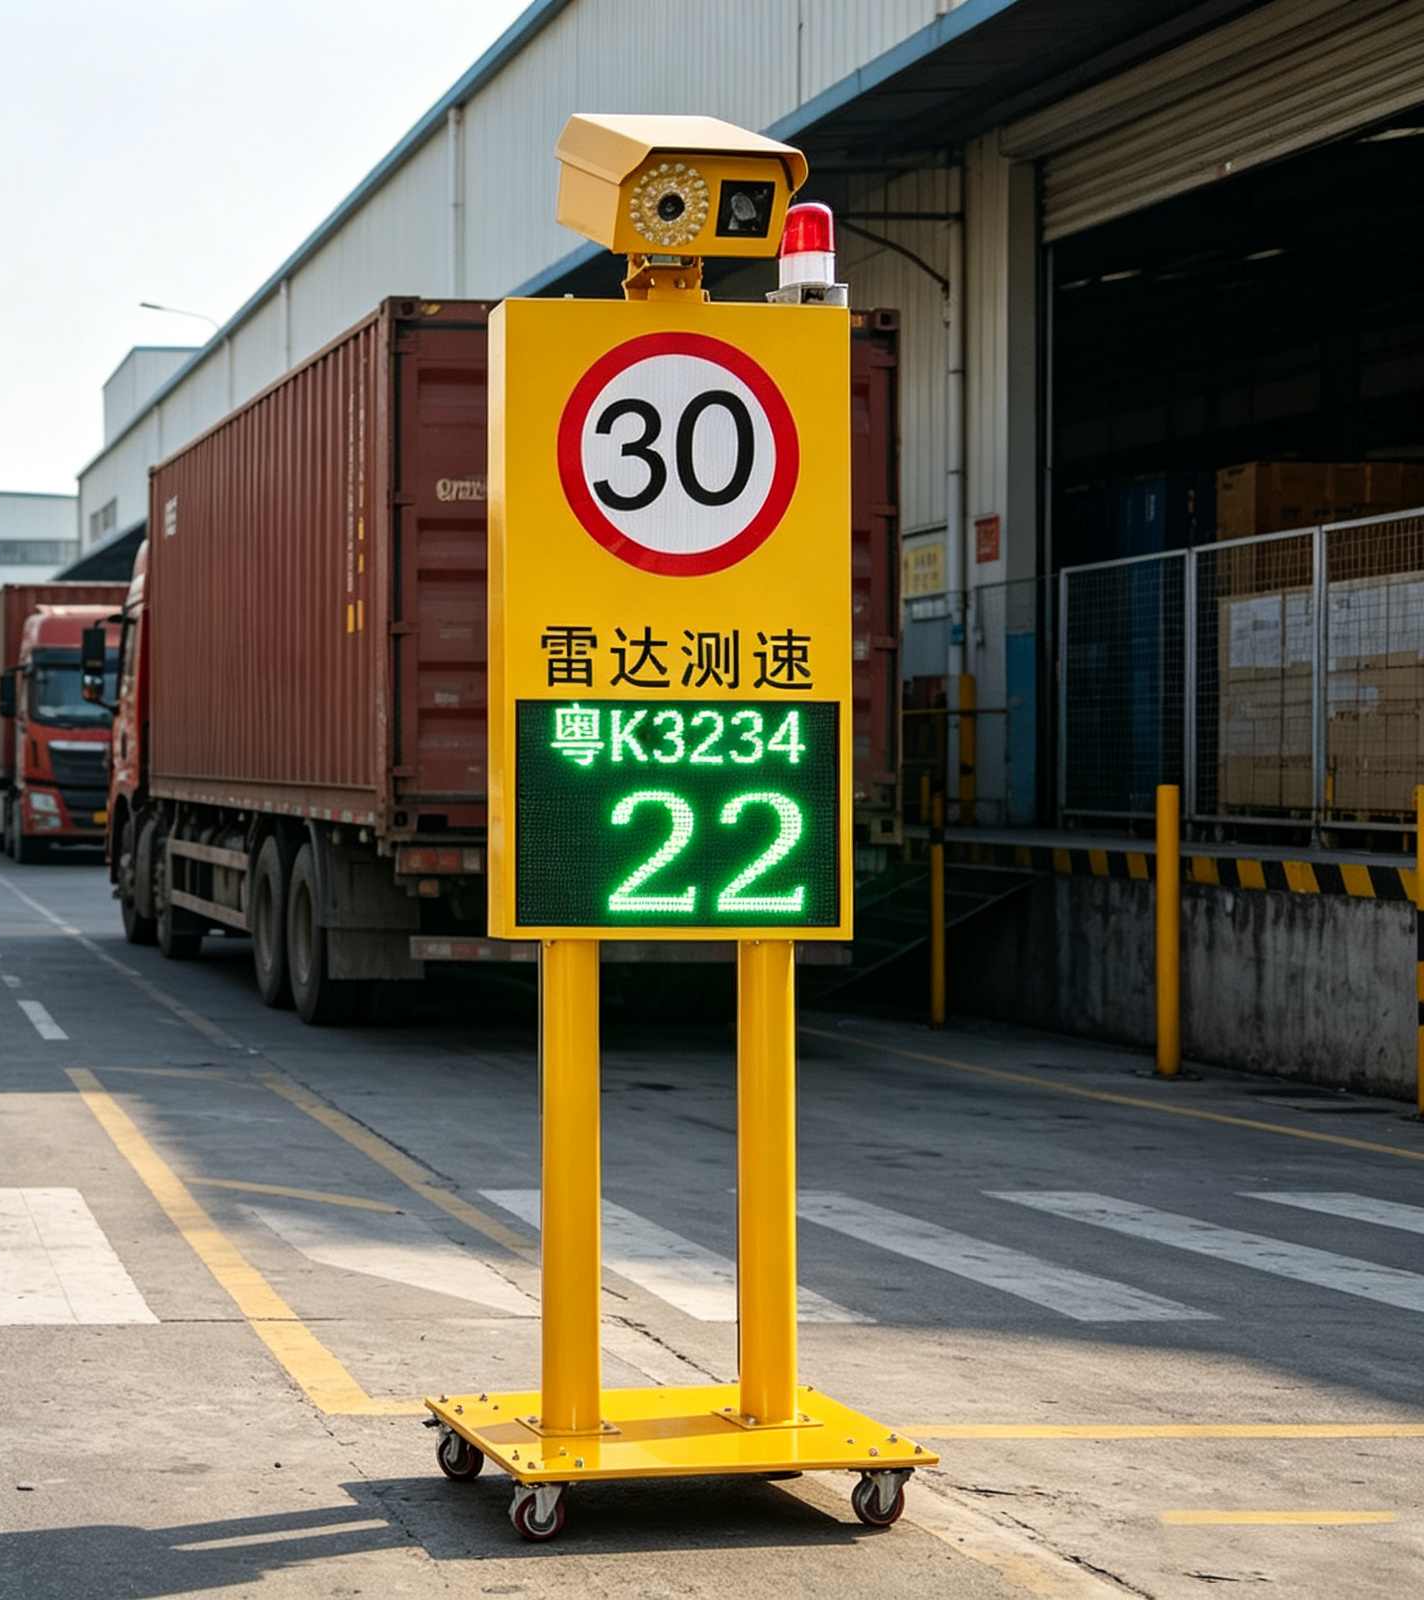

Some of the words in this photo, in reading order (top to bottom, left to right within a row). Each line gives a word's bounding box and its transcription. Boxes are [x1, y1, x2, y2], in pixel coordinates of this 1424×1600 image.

[593, 390, 755, 511] 30
[541, 626, 814, 690] 雷达测速
[550, 703, 806, 766] 粤K3234
[608, 791, 806, 912] 22
